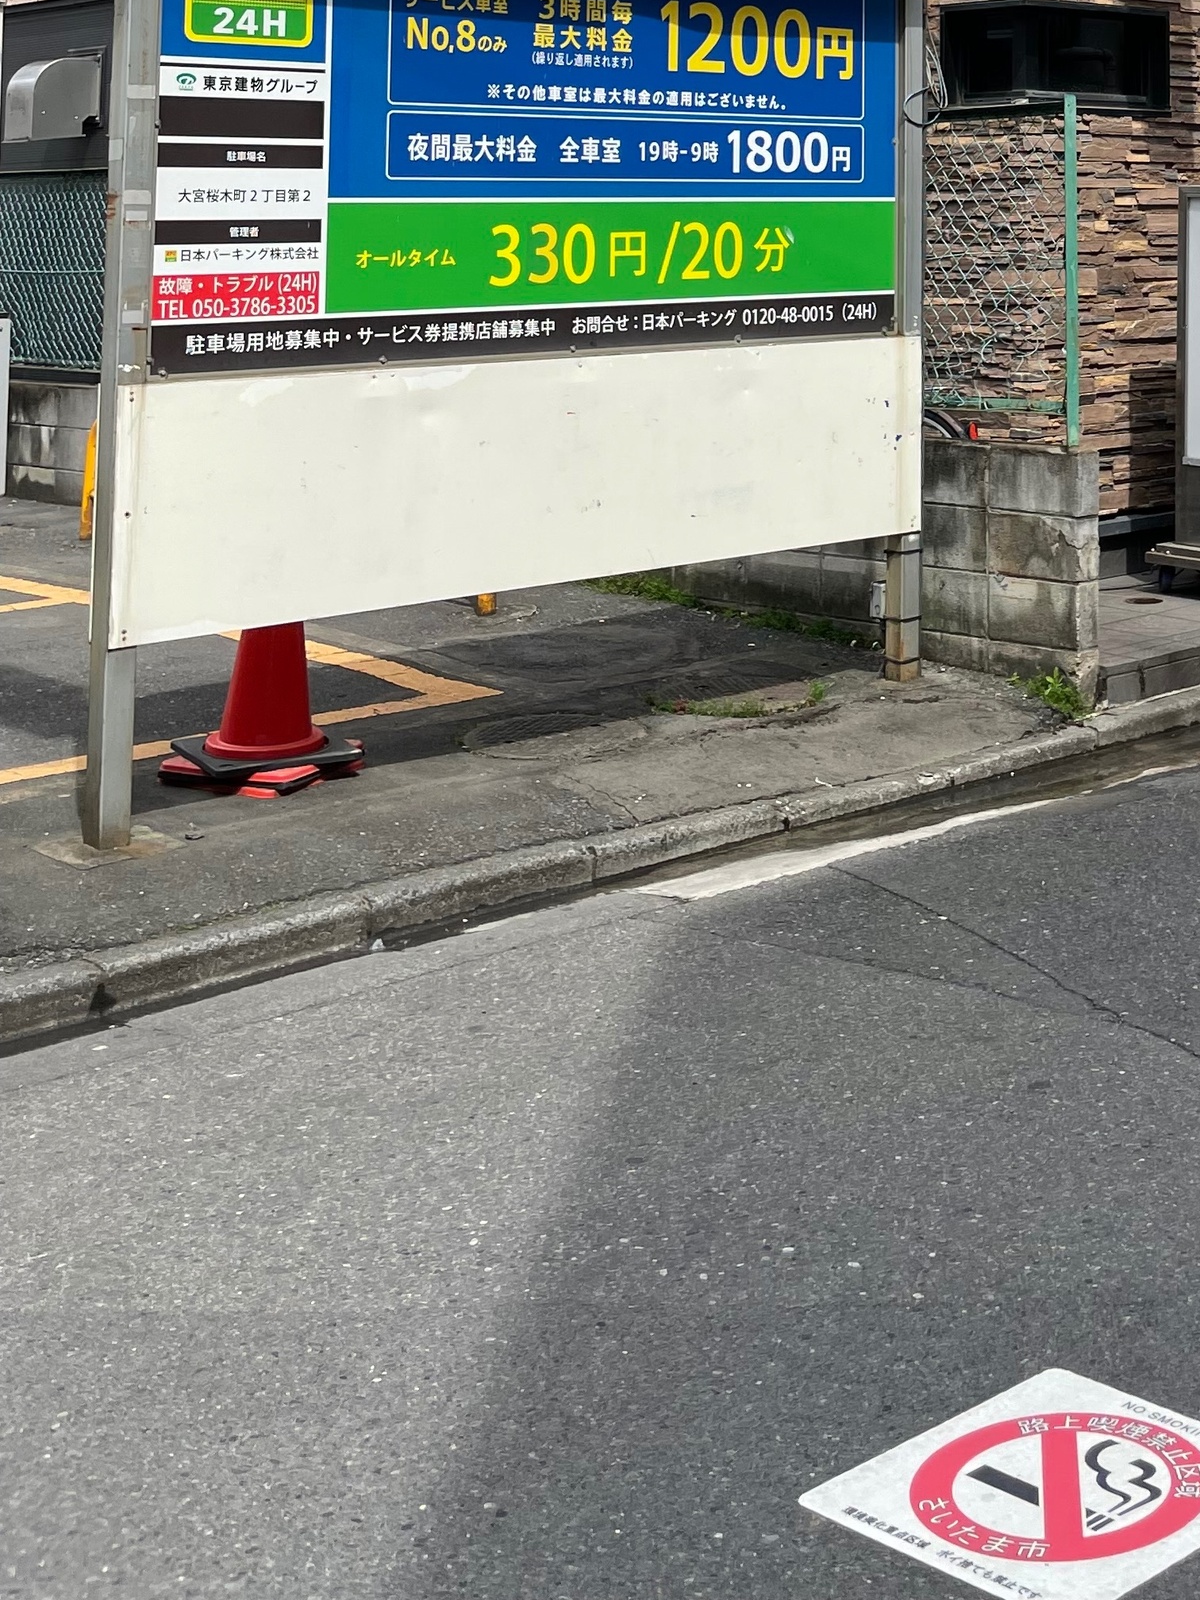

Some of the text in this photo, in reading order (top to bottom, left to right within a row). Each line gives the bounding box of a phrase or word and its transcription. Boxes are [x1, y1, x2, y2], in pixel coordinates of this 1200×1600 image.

[212, 7, 287, 38] 24H
[533, 23, 633, 53] 最大料金
[660, 0, 854, 81] 1200円
[203, 75, 318, 94] 東京建物グループ
[226, 150, 267, 163] 駐車場名
[407, 133, 538, 162] 夜間最大料金
[559, 135, 622, 164] 全車室
[727, 130, 851, 174] 1800円
[178, 188, 311, 204] 大宮桜木町2丁目第2
[229, 227, 260, 239] 管理者
[180, 246, 320, 263] 日本パーキング株式会社
[355, 248, 457, 269] オールタイム
[158, 295, 316, 319] TEL 050-3786-3305
[742, 304, 834, 327] 0120-48-0015
[1121, 1400, 1147, 1415] NO
[918, 1497, 1051, 1559] さいたま市
